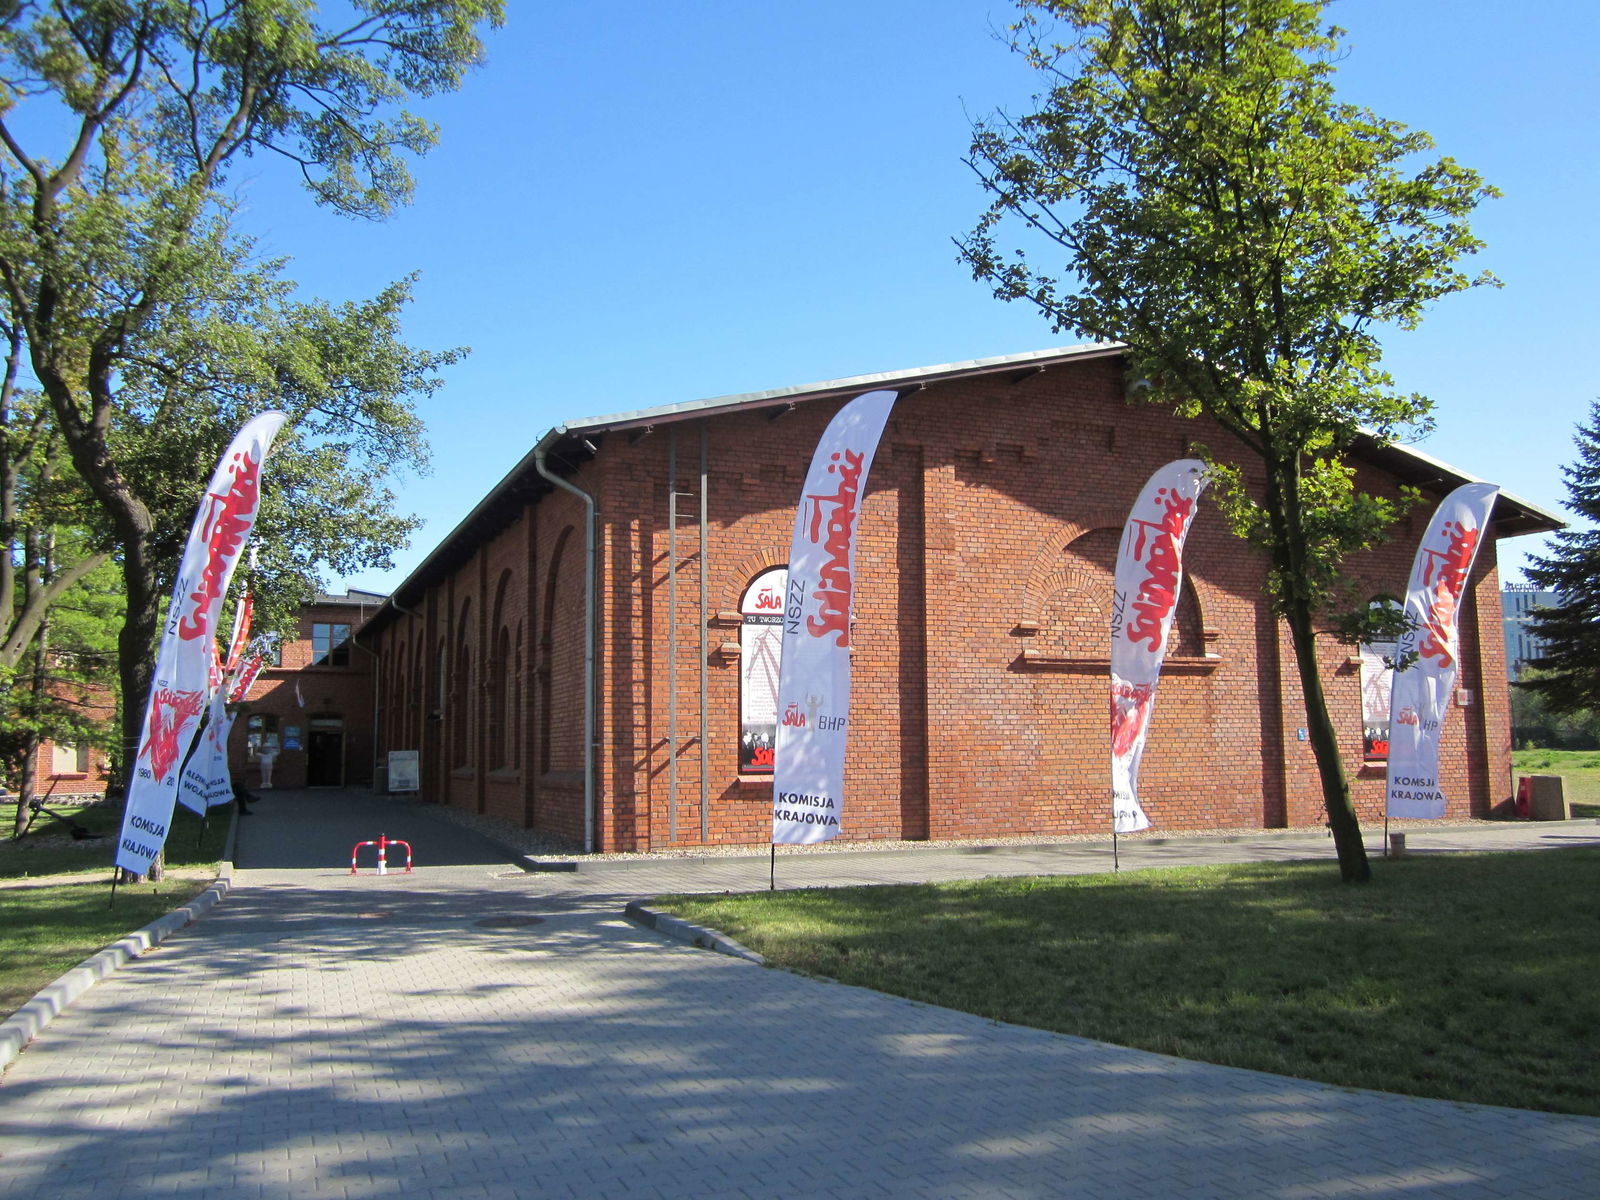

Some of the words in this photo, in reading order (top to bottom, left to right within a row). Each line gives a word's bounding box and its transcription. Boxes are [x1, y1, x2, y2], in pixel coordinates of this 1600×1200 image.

[168, 578, 188, 635] NSZZ
[755, 585, 782, 610] SALA
[787, 579, 805, 634] NSZZ
[1112, 589, 1126, 638] NSZZ
[782, 702, 806, 727] SALA
[818, 715, 845, 731] BHP
[1424, 719, 1438, 731] HP
[779, 792, 835, 809] KOMISJA
[1391, 790, 1443, 801] KRAJOWA
[774, 810, 838, 826] KRAJOWA
